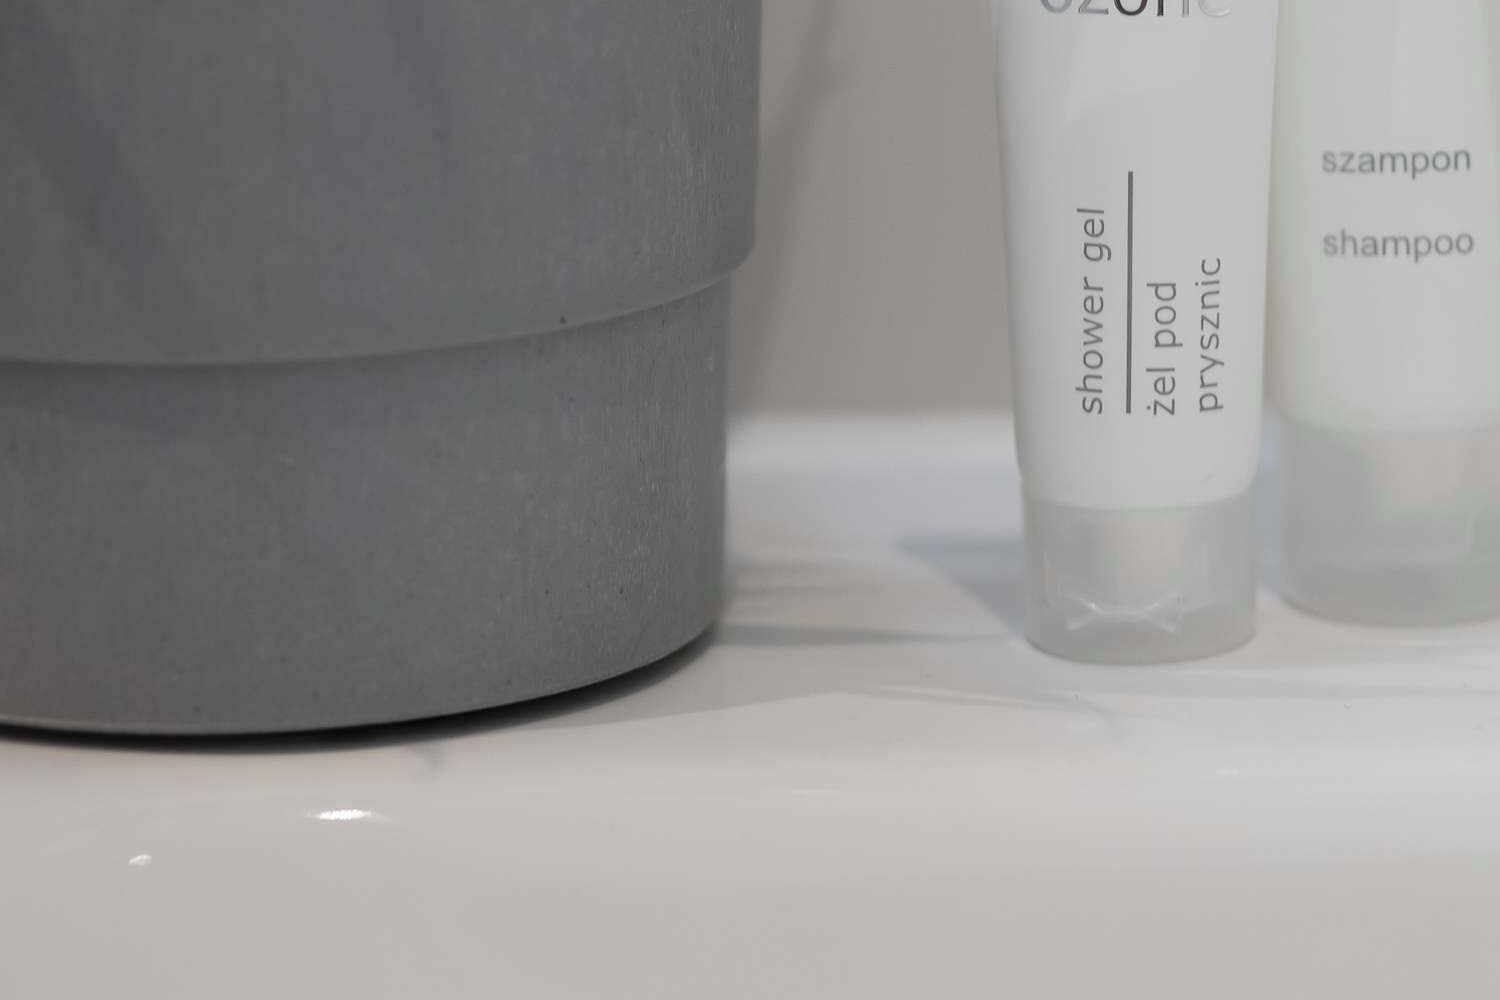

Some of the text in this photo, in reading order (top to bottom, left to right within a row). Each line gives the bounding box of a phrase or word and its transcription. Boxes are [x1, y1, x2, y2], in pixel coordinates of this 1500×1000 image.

[1321, 149, 1472, 181] szampon
[1074, 207, 1112, 415] shower gel
[1322, 228, 1475, 264] shampoo
[1145, 281, 1184, 416] żel pod
[1194, 256, 1225, 413] prysznic
